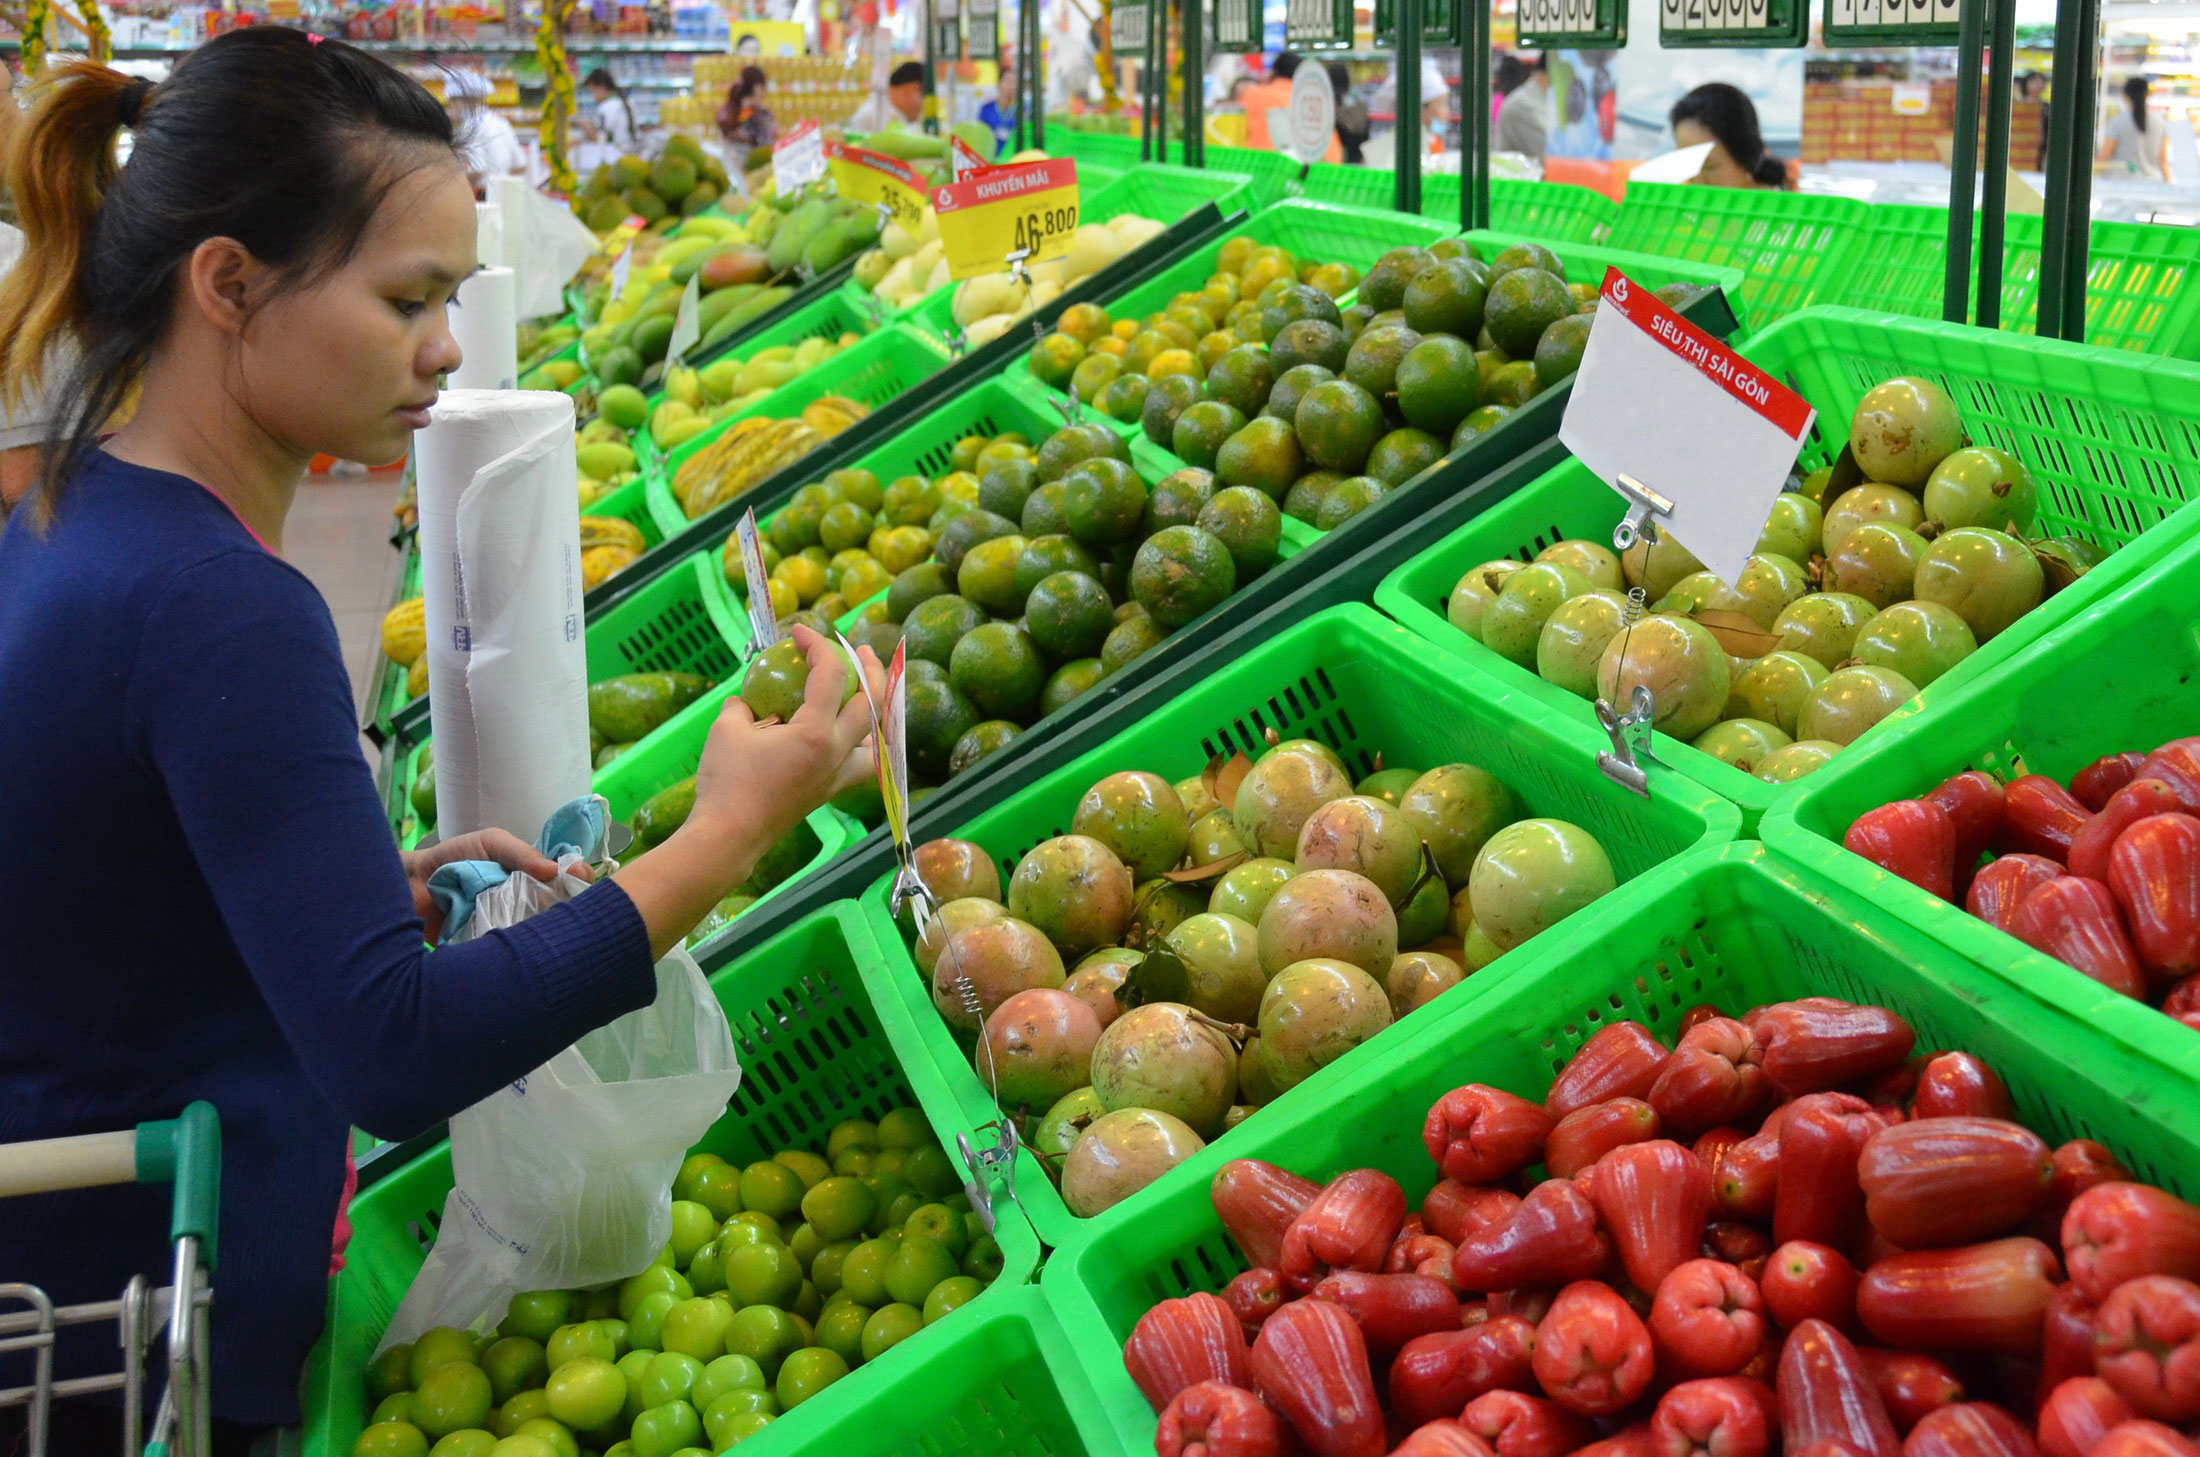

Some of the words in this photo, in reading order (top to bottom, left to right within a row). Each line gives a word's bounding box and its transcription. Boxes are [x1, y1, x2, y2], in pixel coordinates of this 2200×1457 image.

[1015, 206, 1076, 256] 46.800
[1651, 314, 1683, 345] SIÊU
[1683, 335, 1708, 367] THỊ
[1708, 353, 1735, 382] SÀI
[1735, 374, 1769, 405] GÒN
